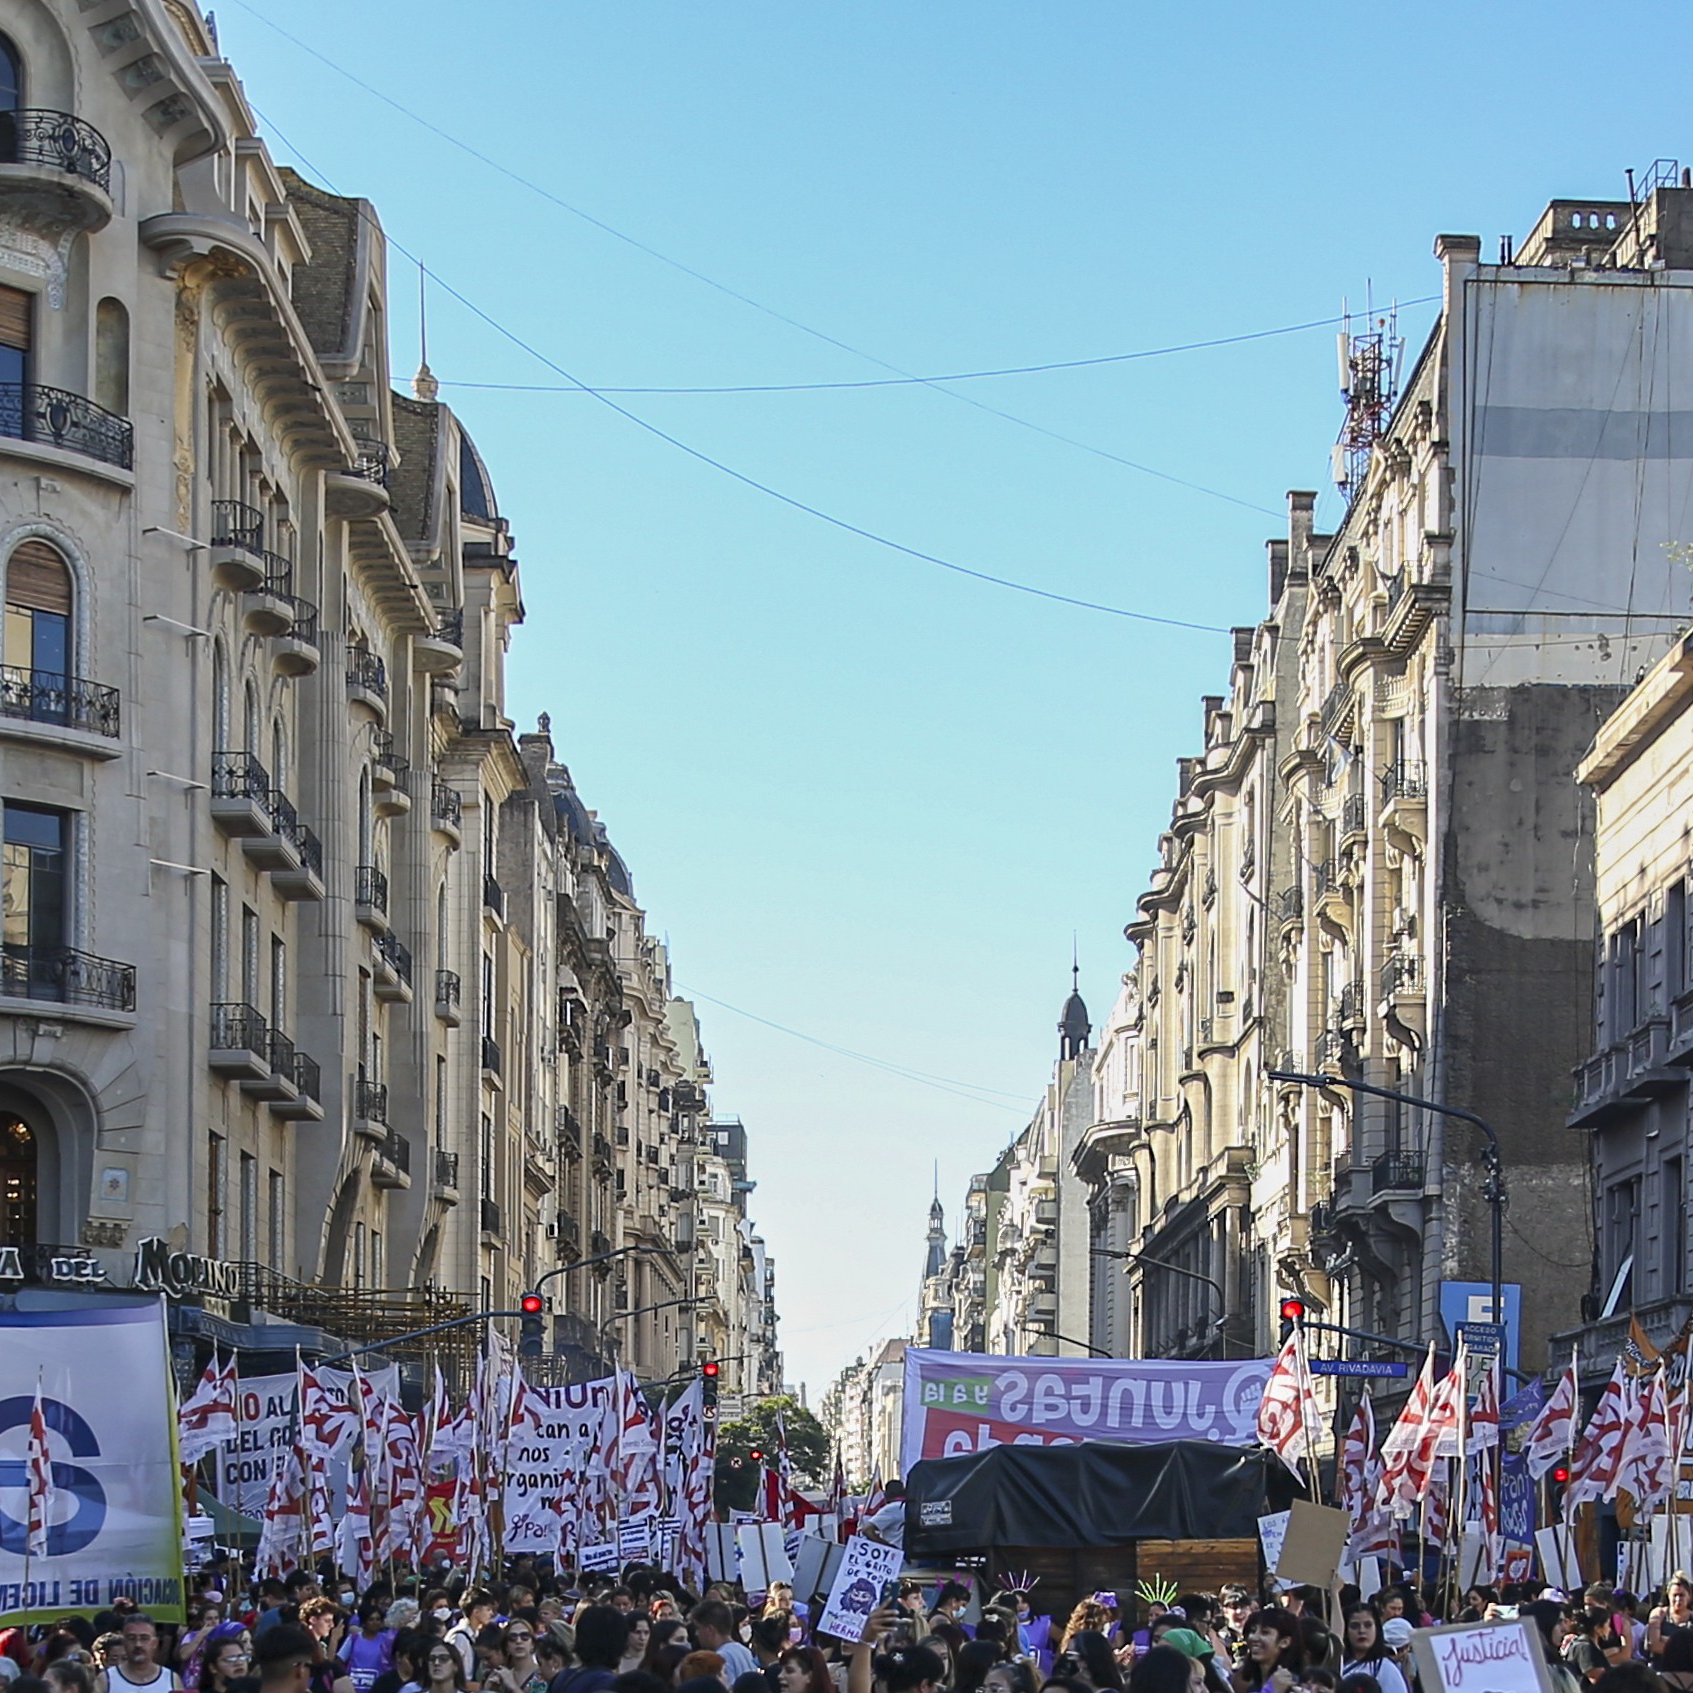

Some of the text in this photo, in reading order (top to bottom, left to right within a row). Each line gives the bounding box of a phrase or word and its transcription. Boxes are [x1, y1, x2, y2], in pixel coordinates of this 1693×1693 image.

[52, 1257, 107, 1282] DEL
[136, 1236, 240, 1298] MOLINO
[1464, 1325, 1497, 1334] ACCESO
[1464, 1334, 1500, 1343] ERMITIDO
[1319, 1363, 1392, 1375] AV. RIVADAVIA
[518, 1446, 550, 1463] nos
[226, 1461, 266, 1484] CON
[859, 1543, 890, 1561] SOY
[848, 1554, 893, 1575] EL GRITO
[1442, 1627, 1529, 1687] ¡Justicia!
